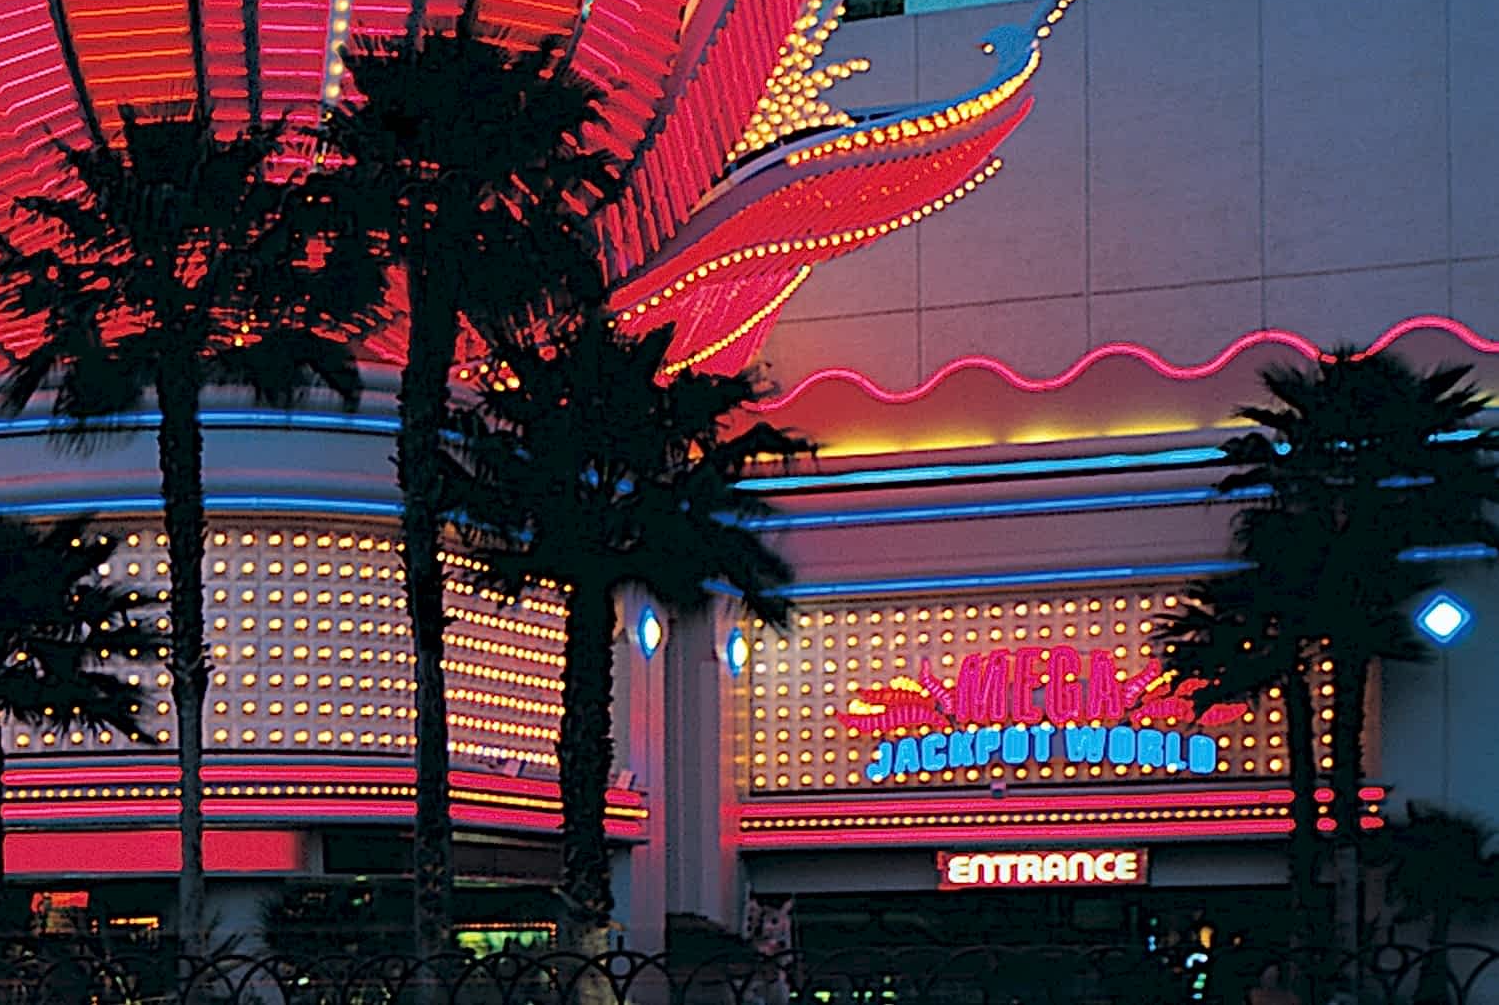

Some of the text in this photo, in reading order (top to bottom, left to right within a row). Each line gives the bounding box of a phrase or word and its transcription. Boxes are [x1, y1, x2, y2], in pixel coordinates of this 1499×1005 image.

[956, 645, 1124, 725] MEGA
[866, 725, 1218, 781] JACKPOT WORLD
[948, 852, 1138, 884] ENTRANCE
